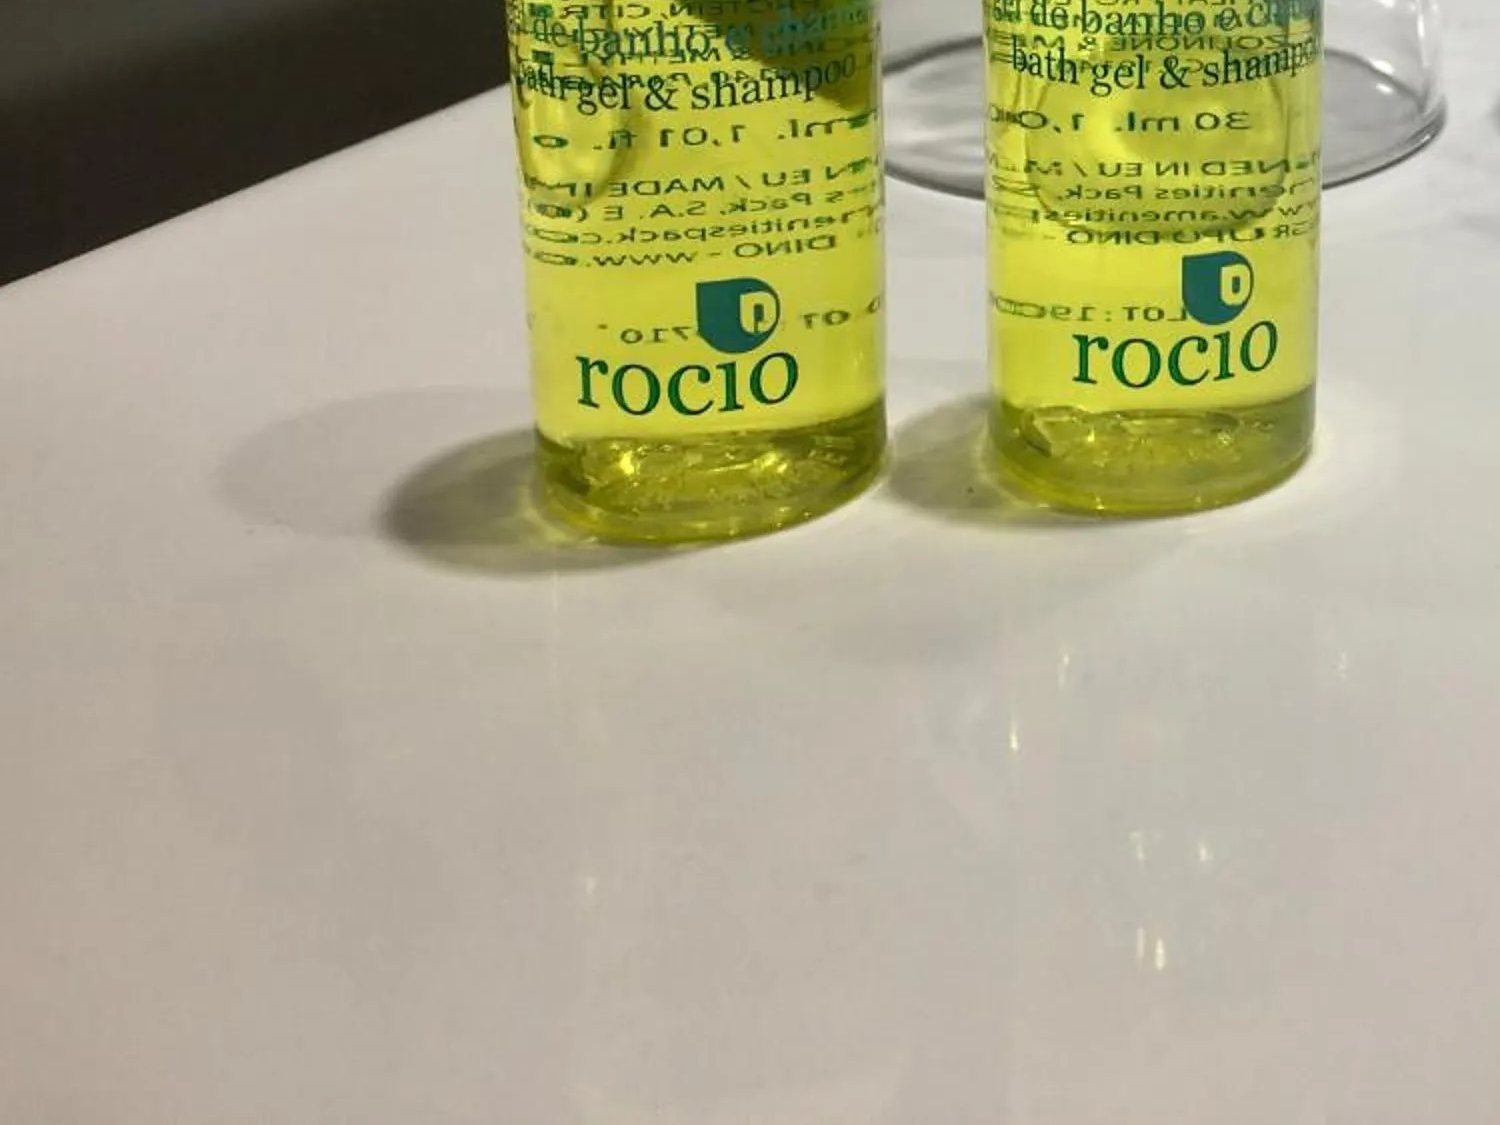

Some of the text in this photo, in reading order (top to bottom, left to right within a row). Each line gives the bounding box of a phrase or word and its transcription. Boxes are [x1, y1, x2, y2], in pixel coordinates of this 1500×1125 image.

[644, 74, 678, 111] &
[691, 53, 856, 110] shampoo
[1089, 53, 1147, 97] gel
[1159, 55, 1191, 89] &
